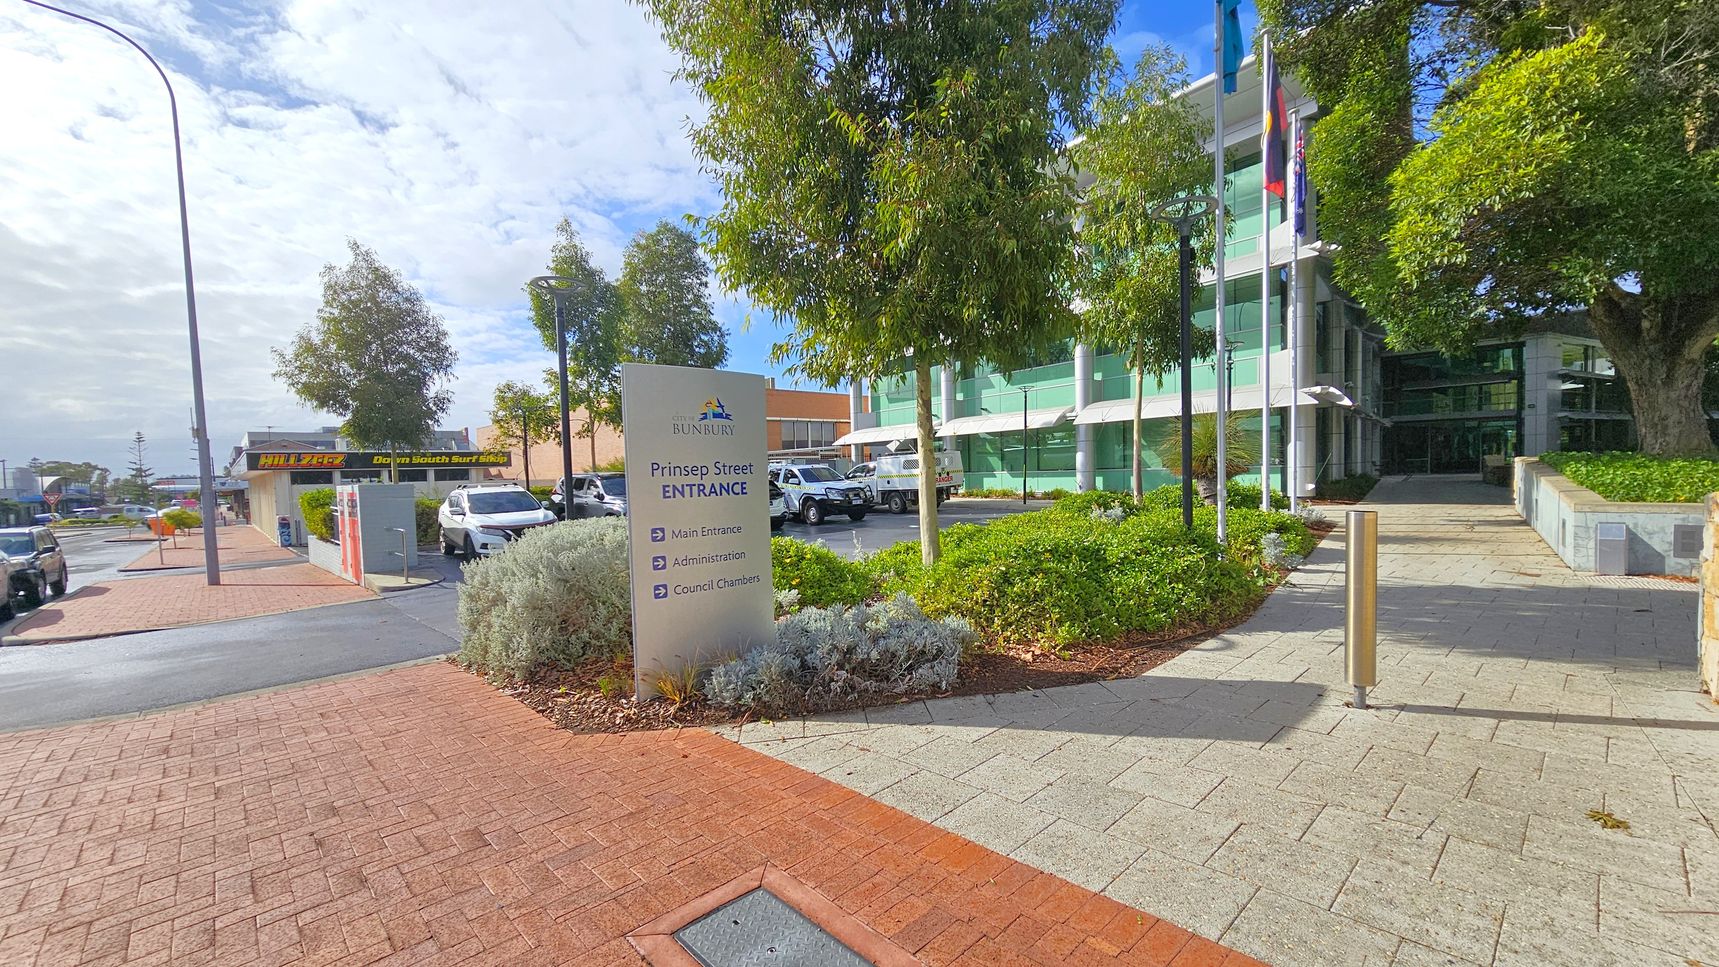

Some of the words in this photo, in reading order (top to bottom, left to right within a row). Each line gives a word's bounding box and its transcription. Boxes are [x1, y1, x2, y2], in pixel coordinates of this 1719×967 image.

[673, 423, 735, 436] BUNBURY
[258, 453, 347, 469] HILLZEEZ
[411, 455, 449, 464] South
[451, 455, 478, 463] Surf
[479, 455, 508, 464] Shop
[651, 461, 709, 480] Prinsep
[714, 461, 754, 476] Street
[662, 481, 748, 499] ENTRANCE
[671, 527, 699, 539] Main
[701, 525, 742, 537] Entrance
[672, 550, 746, 568] Administration
[673, 580, 714, 595] Council
[716, 574, 761, 589] Chambers
